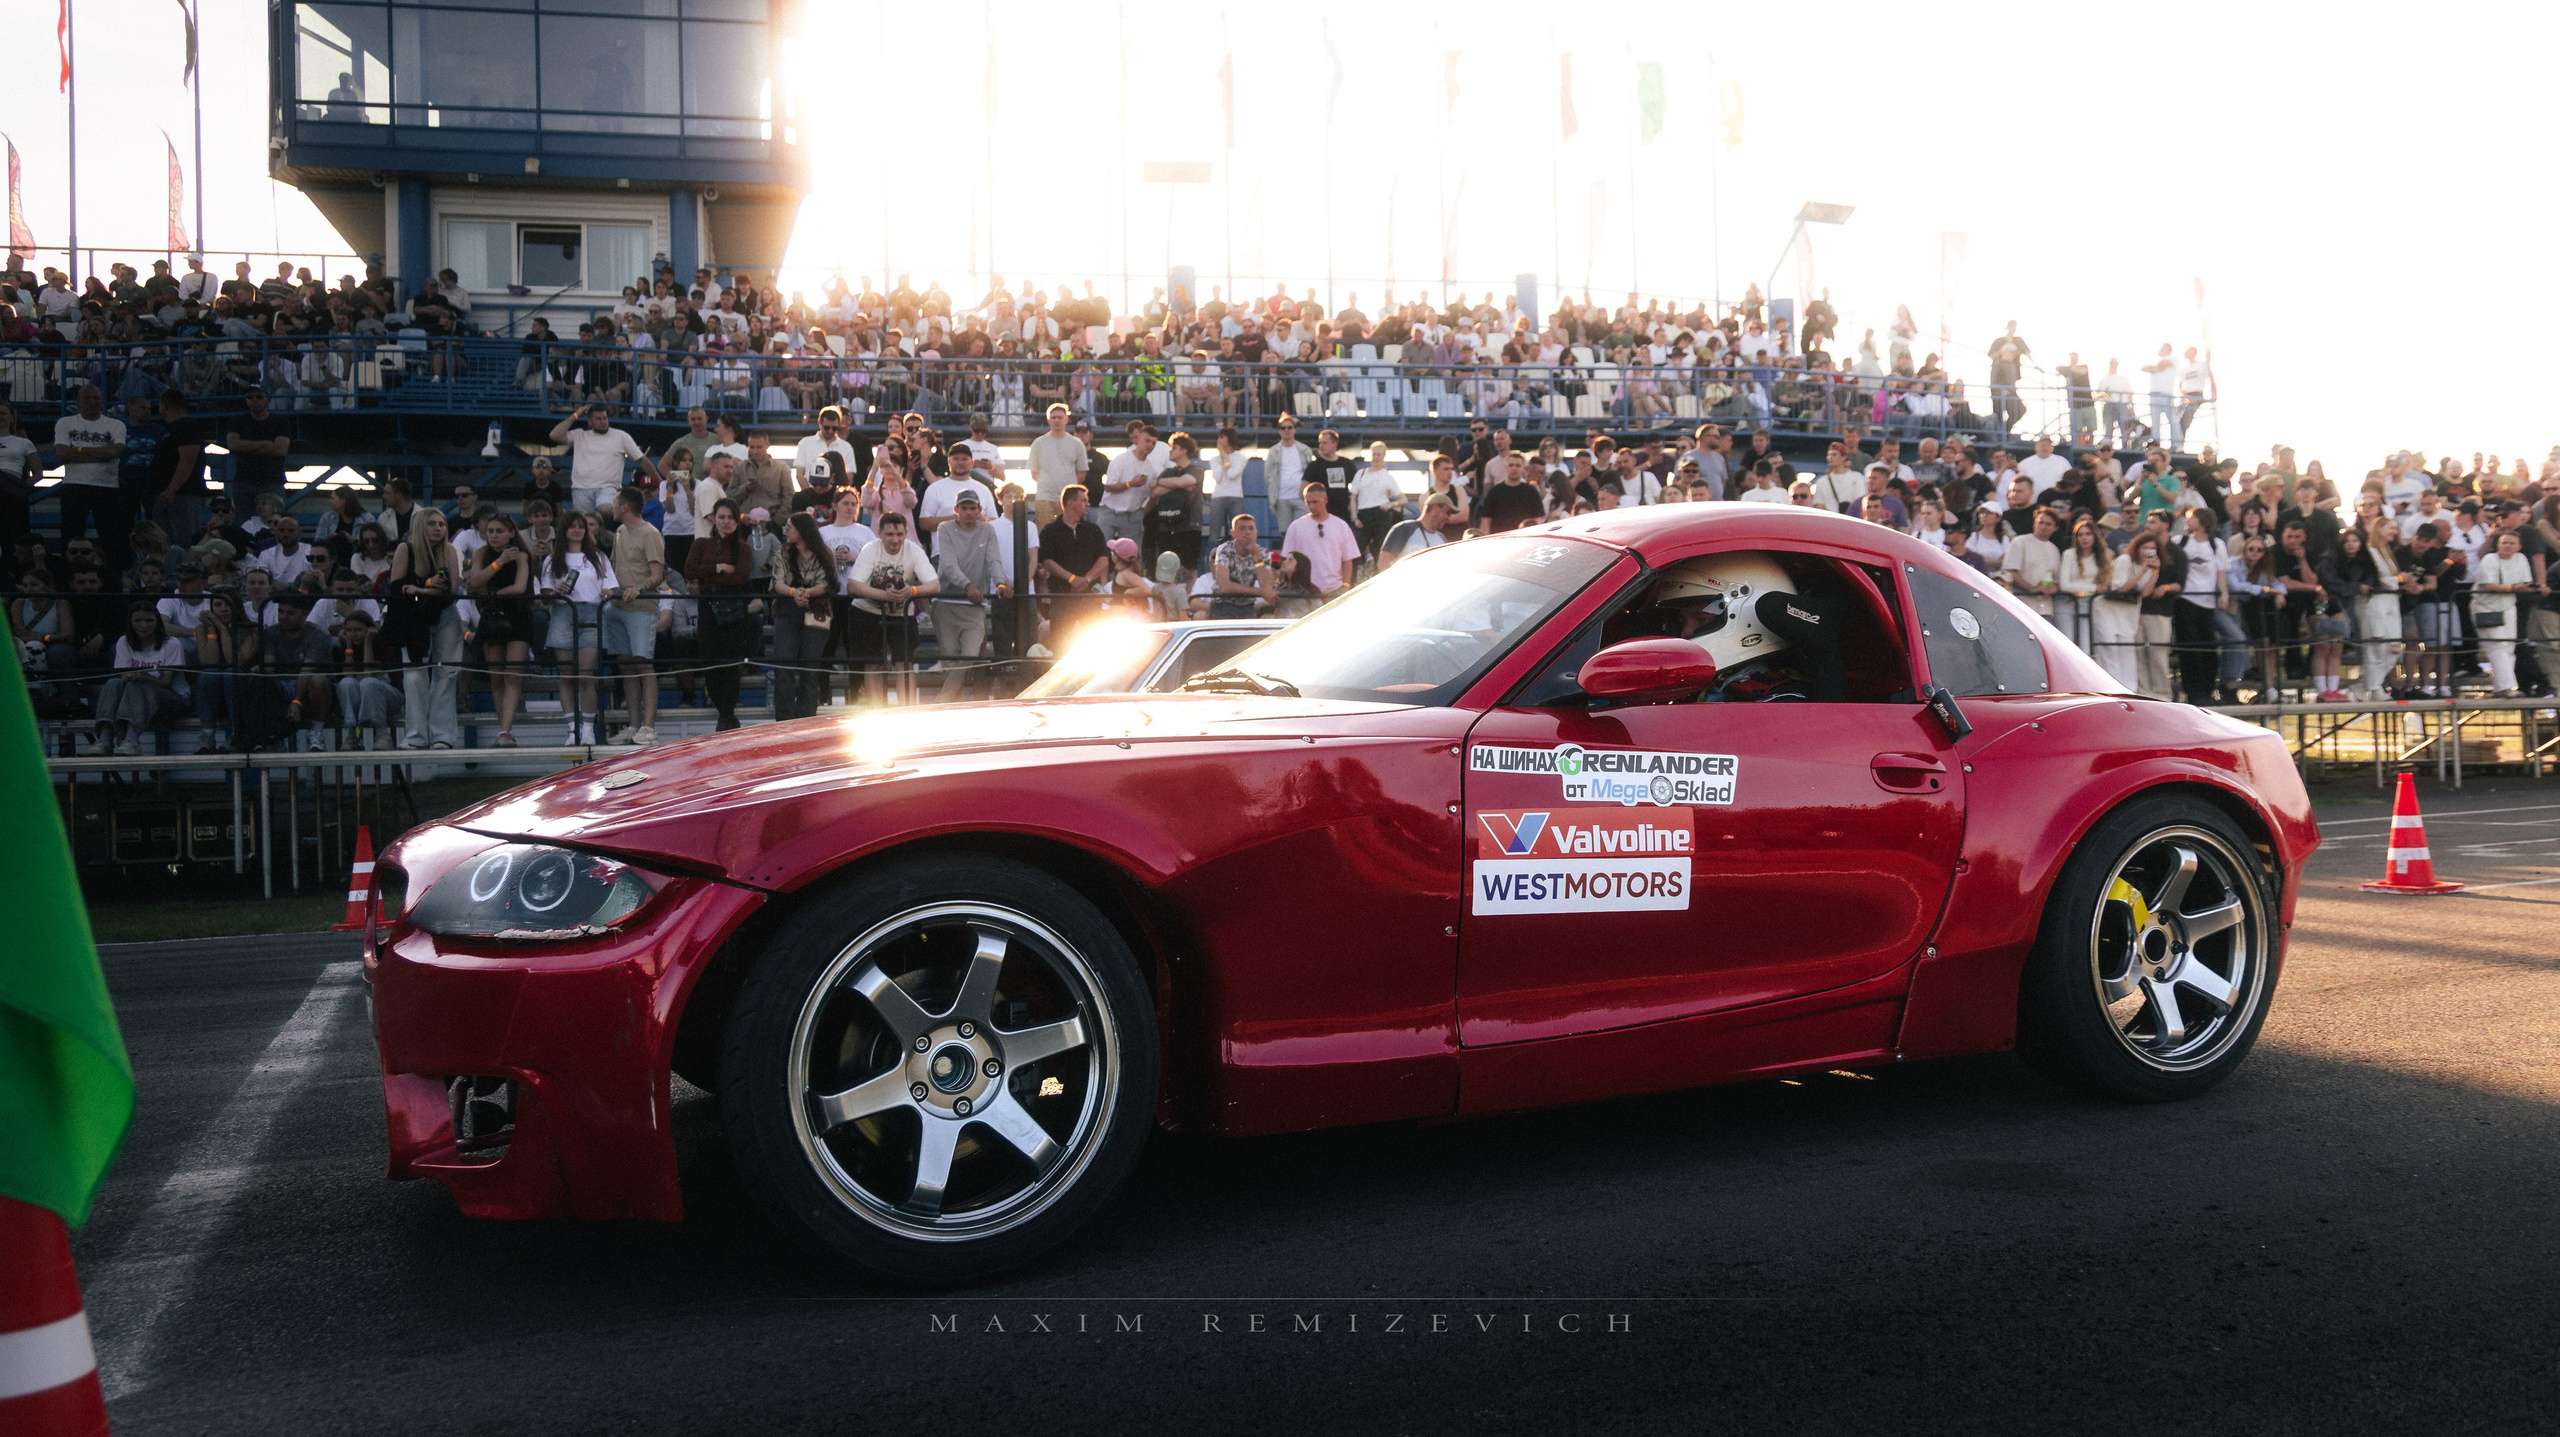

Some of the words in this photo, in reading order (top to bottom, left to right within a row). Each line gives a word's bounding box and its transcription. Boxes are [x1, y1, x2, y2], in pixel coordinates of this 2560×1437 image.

[1472, 748, 1496, 769] НА
[1500, 749, 1558, 772] ШИНАХ
[1673, 780, 1732, 802] Sklad
[1550, 824, 1691, 854] Valvoline
[1481, 871, 1683, 901] WESTMOTORS
